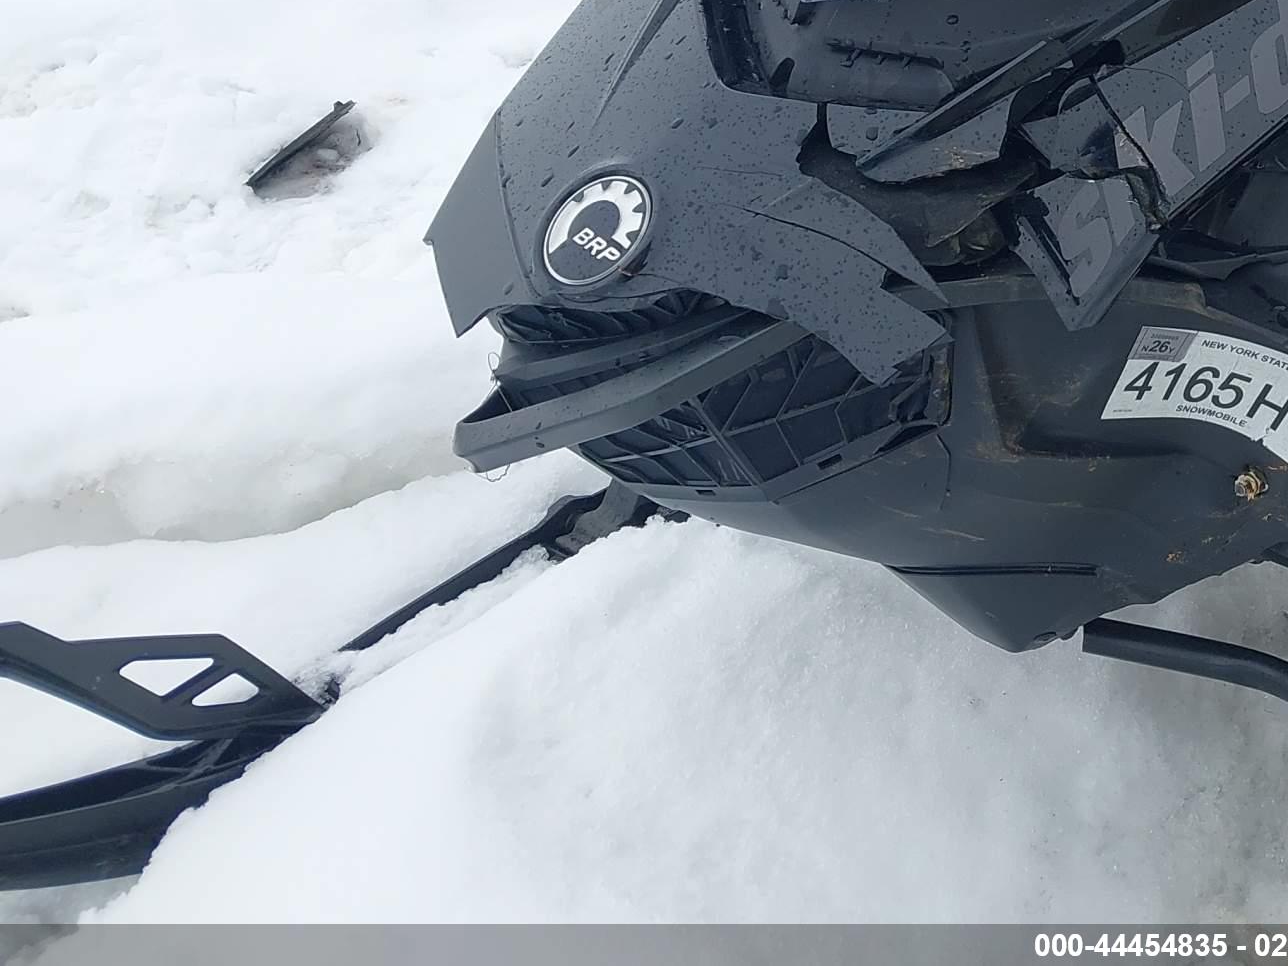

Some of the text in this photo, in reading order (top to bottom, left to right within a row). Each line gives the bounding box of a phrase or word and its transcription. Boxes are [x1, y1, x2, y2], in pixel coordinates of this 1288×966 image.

[572, 227, 621, 261] BRP
[1201, 339, 1228, 351] NEW
[1229, 344, 1260, 361] YORK
[1175, 404, 1248, 428] SNOWMOBILE
